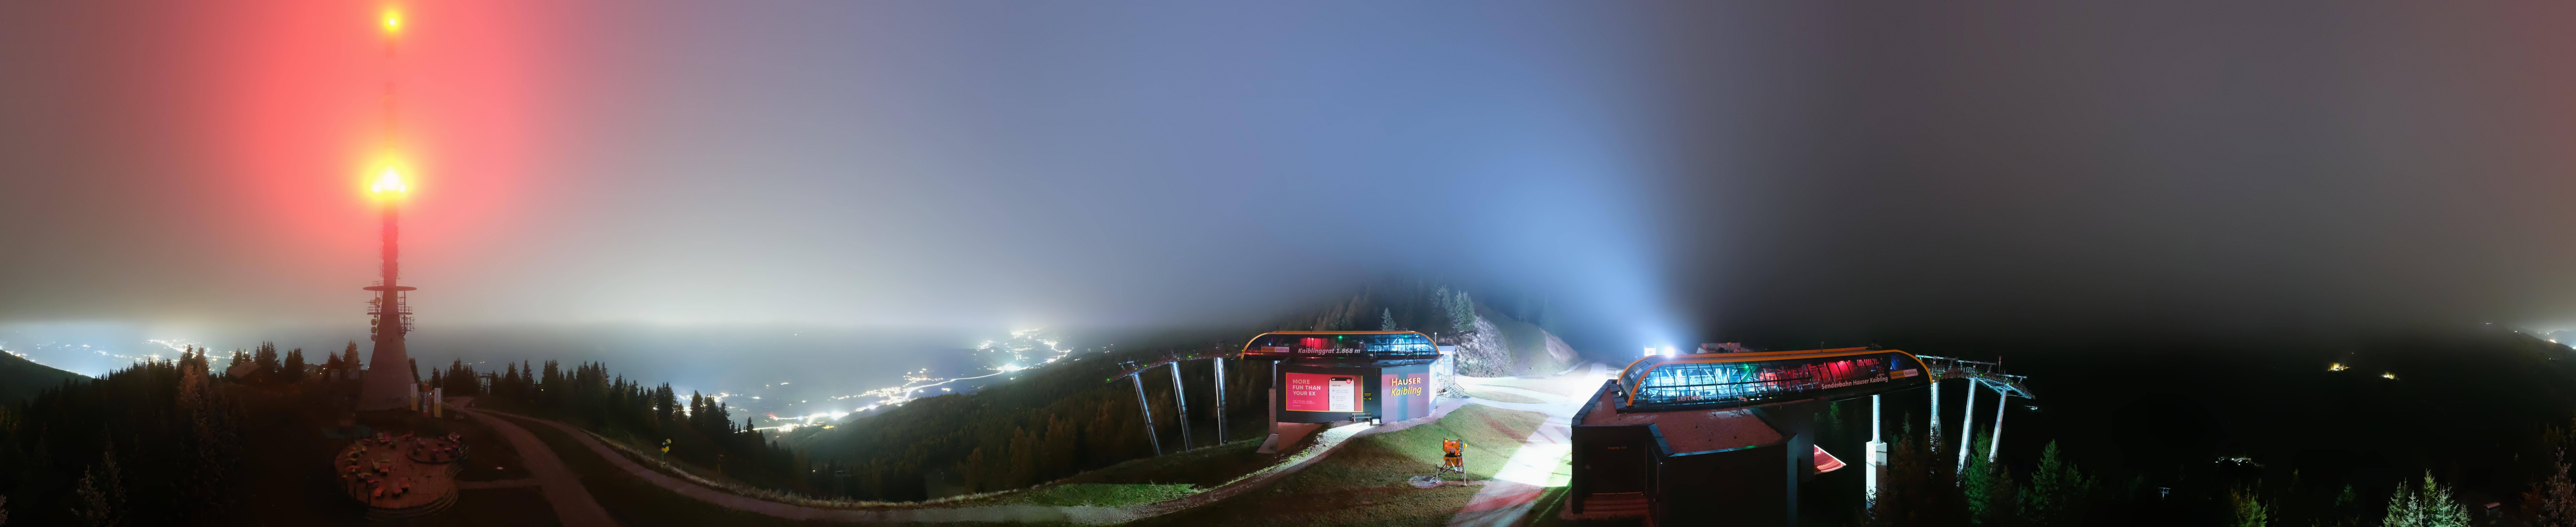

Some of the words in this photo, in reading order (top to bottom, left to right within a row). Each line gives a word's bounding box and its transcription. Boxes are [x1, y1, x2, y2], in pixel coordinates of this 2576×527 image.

[1391, 378, 1421, 386] HAUSER
[1821, 381, 1852, 389] Senderbahn
[1391, 386, 1421, 396] Kaibling
